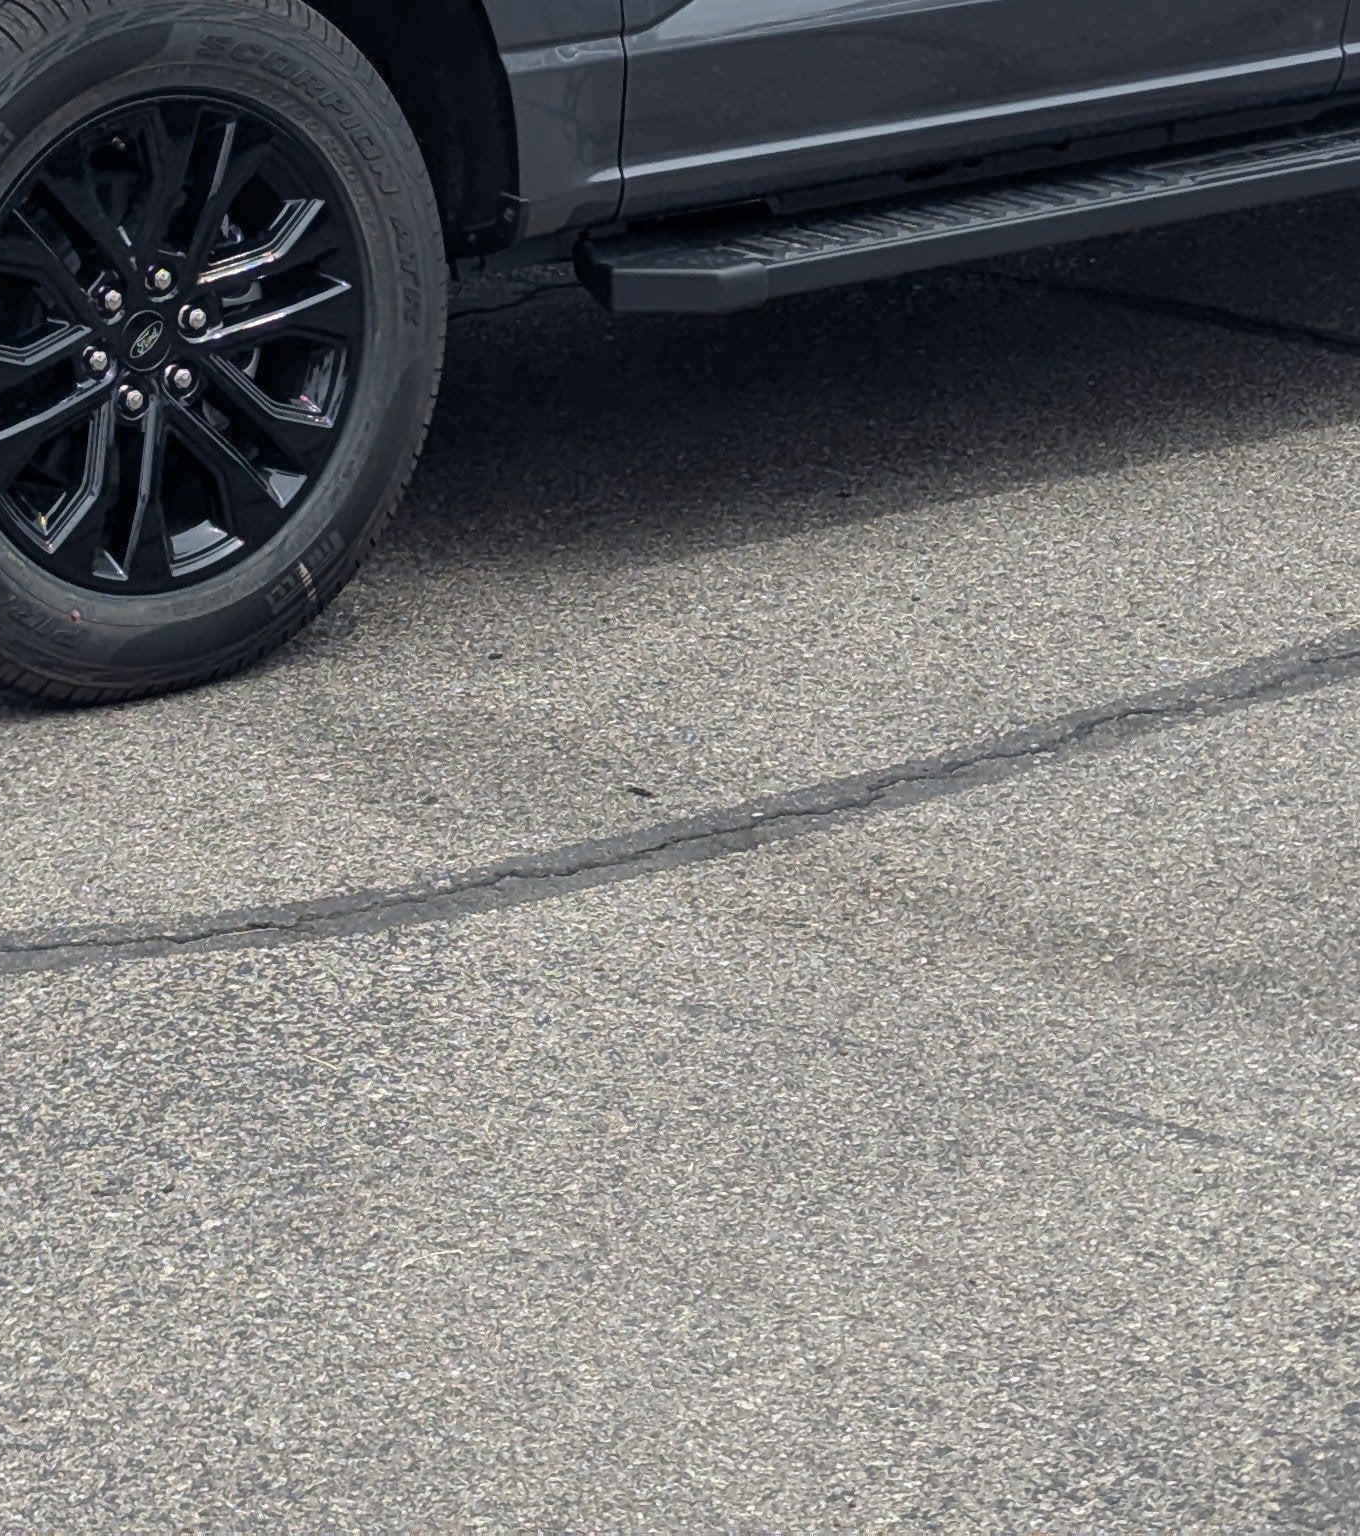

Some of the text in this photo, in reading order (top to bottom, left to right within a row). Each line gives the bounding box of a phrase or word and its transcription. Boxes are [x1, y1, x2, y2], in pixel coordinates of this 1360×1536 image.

[196, 32, 400, 196] SCORPION
[388, 214, 423, 327] ATR
[135, 326, 158, 355] Ford
